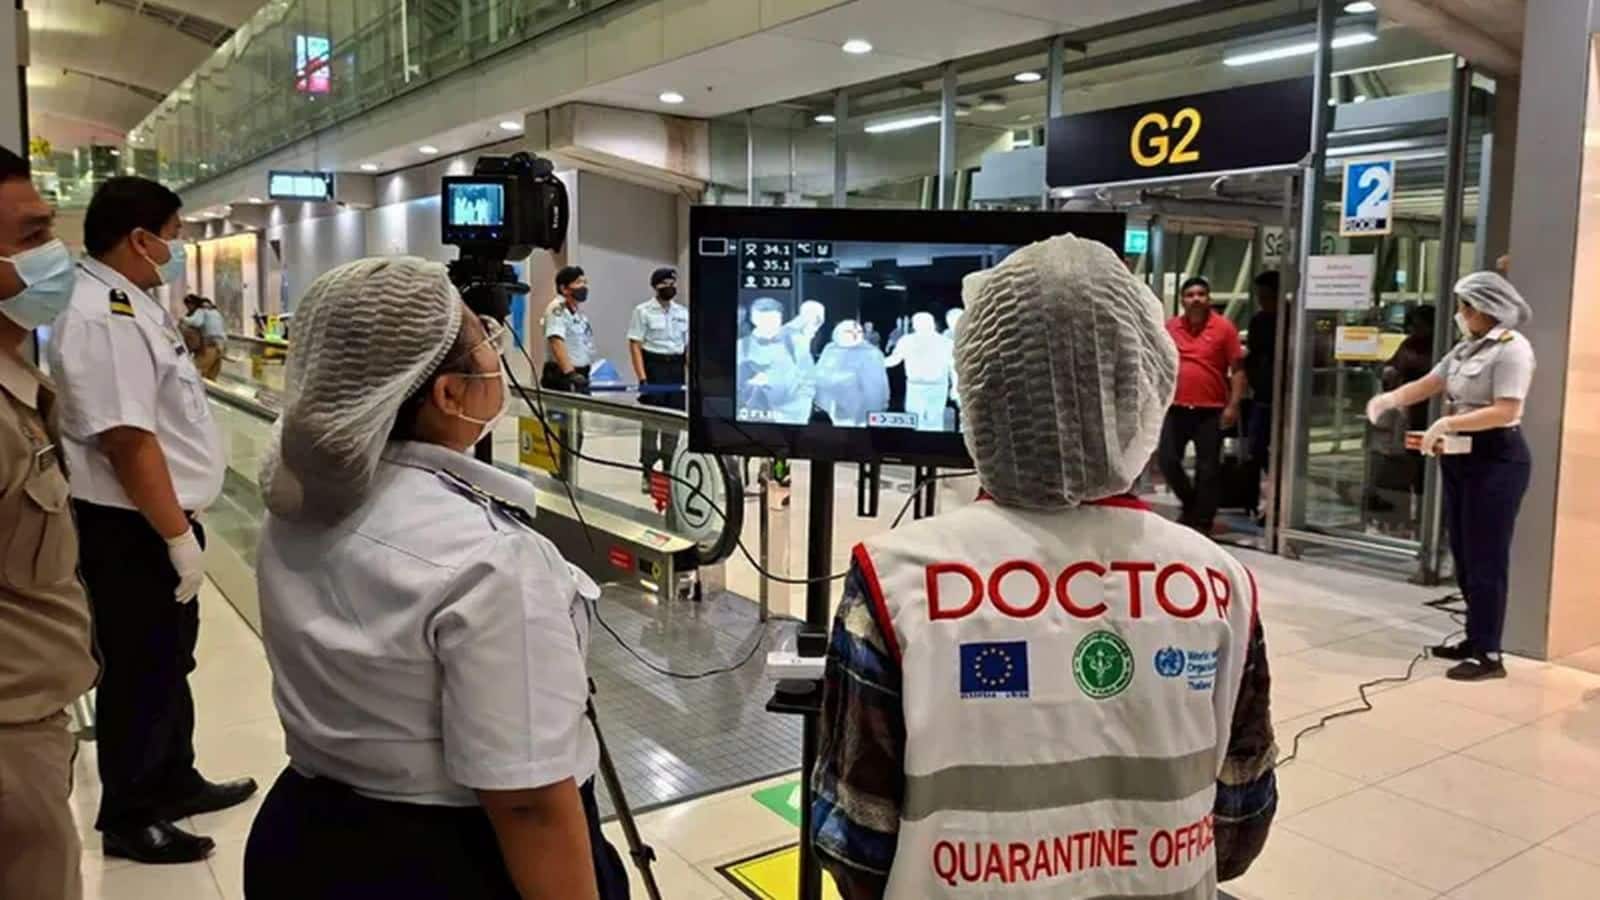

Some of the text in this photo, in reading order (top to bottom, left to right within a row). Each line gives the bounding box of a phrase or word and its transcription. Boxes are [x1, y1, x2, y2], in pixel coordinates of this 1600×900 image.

[1131, 107, 1201, 167] G2
[1357, 166, 1391, 216] 2
[763, 244, 790, 256] 34.1
[763, 260, 790, 271] 35.1
[763, 276, 791, 287] 33.8
[685, 459, 704, 518] 2
[925, 560, 1231, 621] DOCTOR
[933, 828, 1138, 886] QUARANTINE
